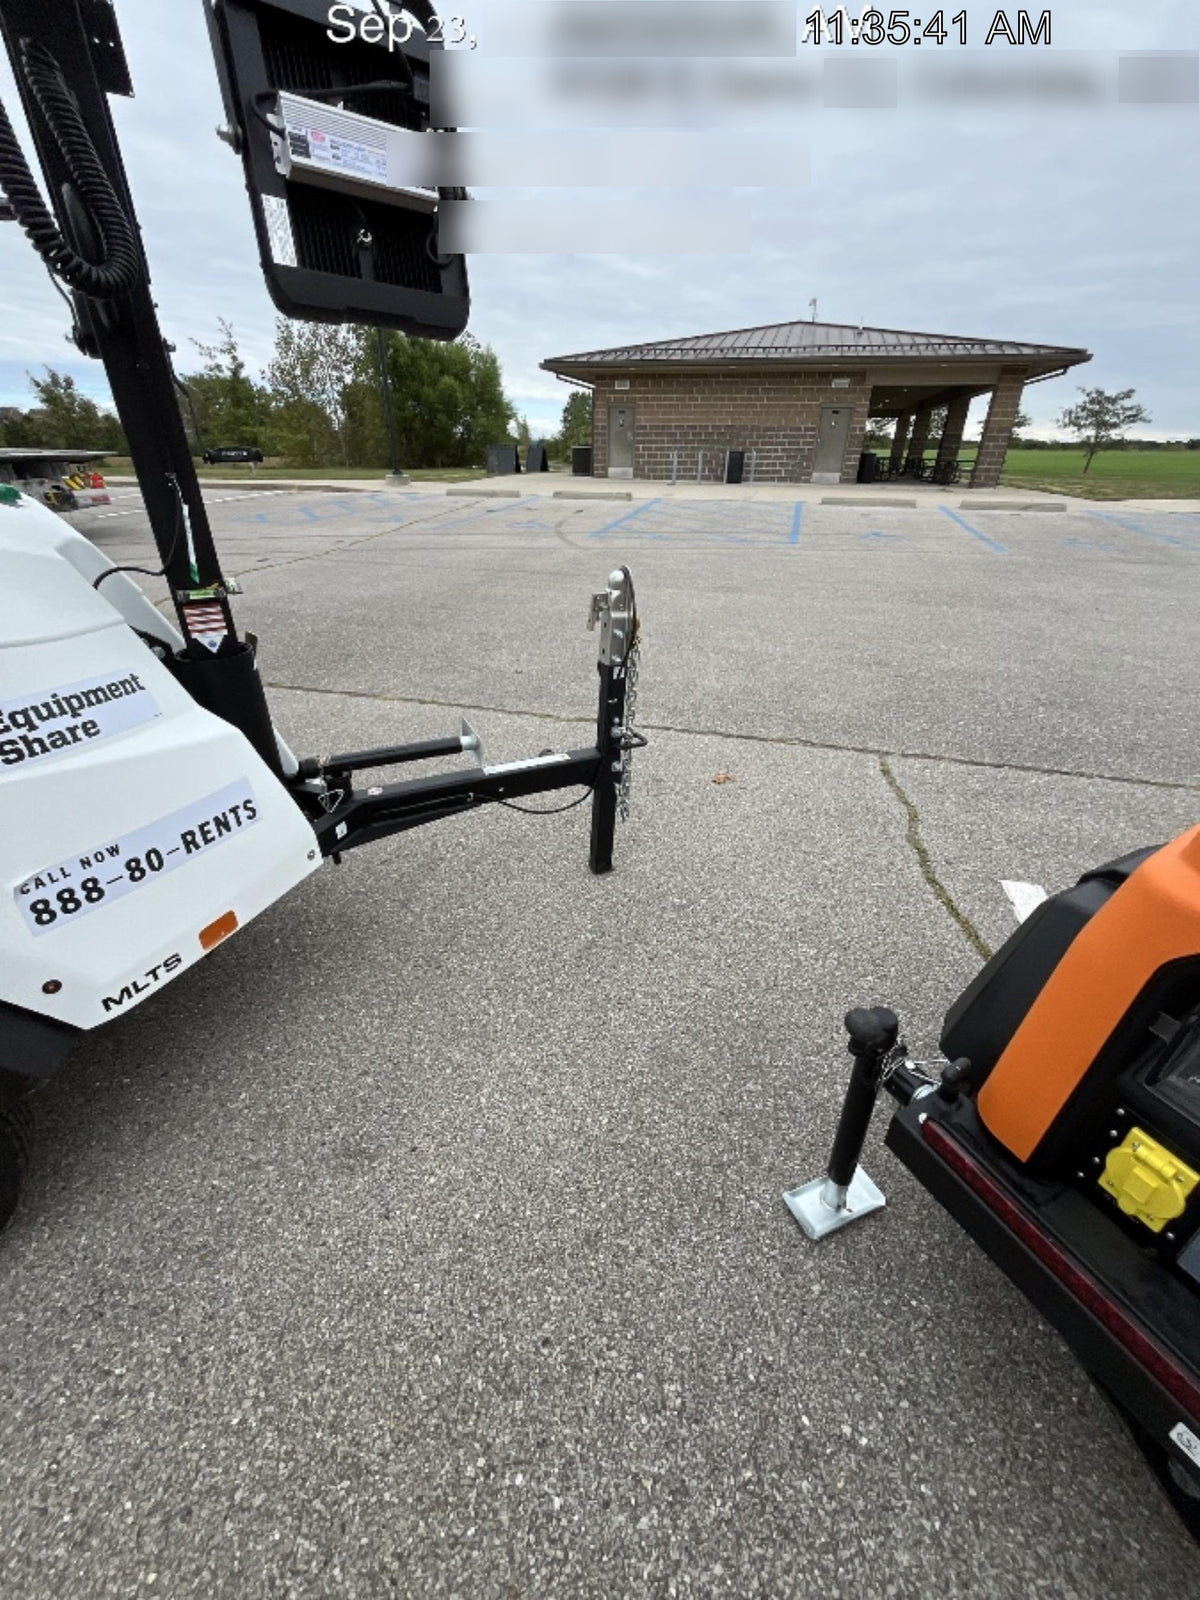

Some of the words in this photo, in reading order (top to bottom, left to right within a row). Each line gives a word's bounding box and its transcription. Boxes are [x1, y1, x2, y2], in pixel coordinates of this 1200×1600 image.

[0, 719, 101, 765] Share
[19, 867, 71, 895] CALL
[79, 844, 121, 870] NOW
[29, 799, 257, 926] 888-80-RENTS
[101, 953, 182, 1012] MLTS
